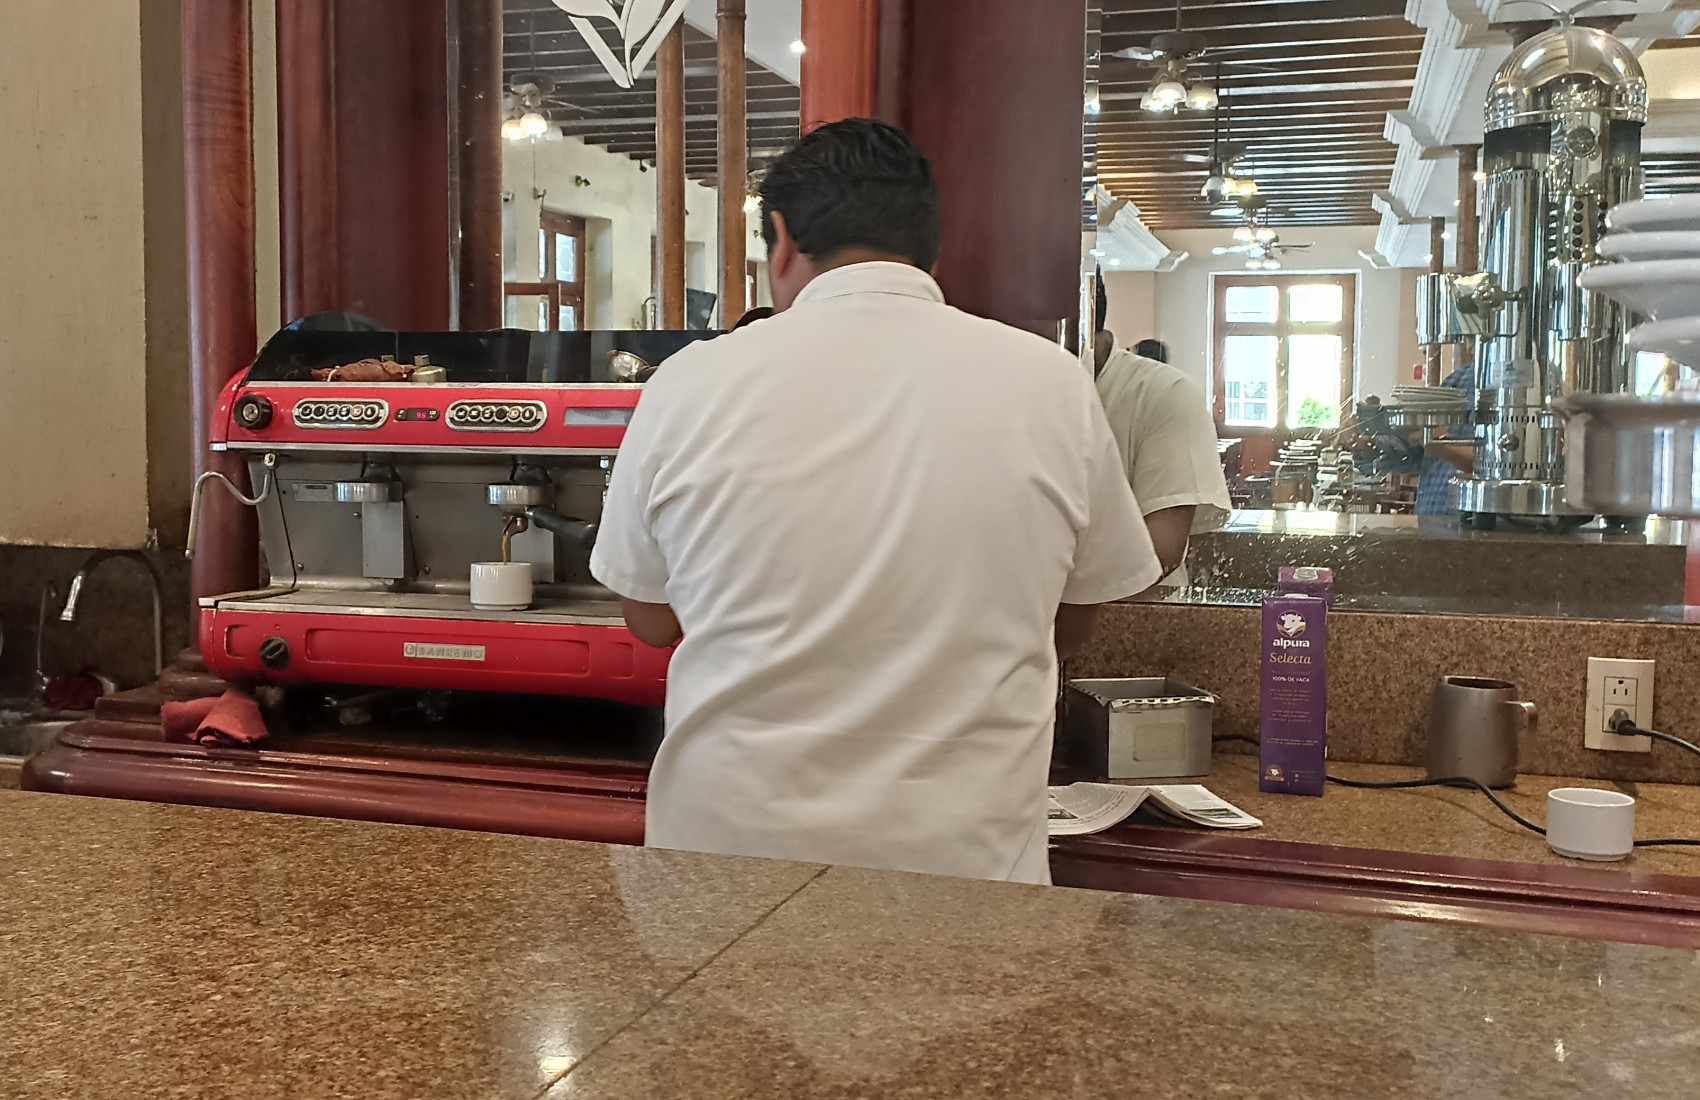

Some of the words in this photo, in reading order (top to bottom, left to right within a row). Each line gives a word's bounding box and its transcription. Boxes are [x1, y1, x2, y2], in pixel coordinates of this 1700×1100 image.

[1272, 637, 1310, 650] alpura
[417, 646, 484, 659] SANREMO
[1269, 652, 1312, 665] Selecta
